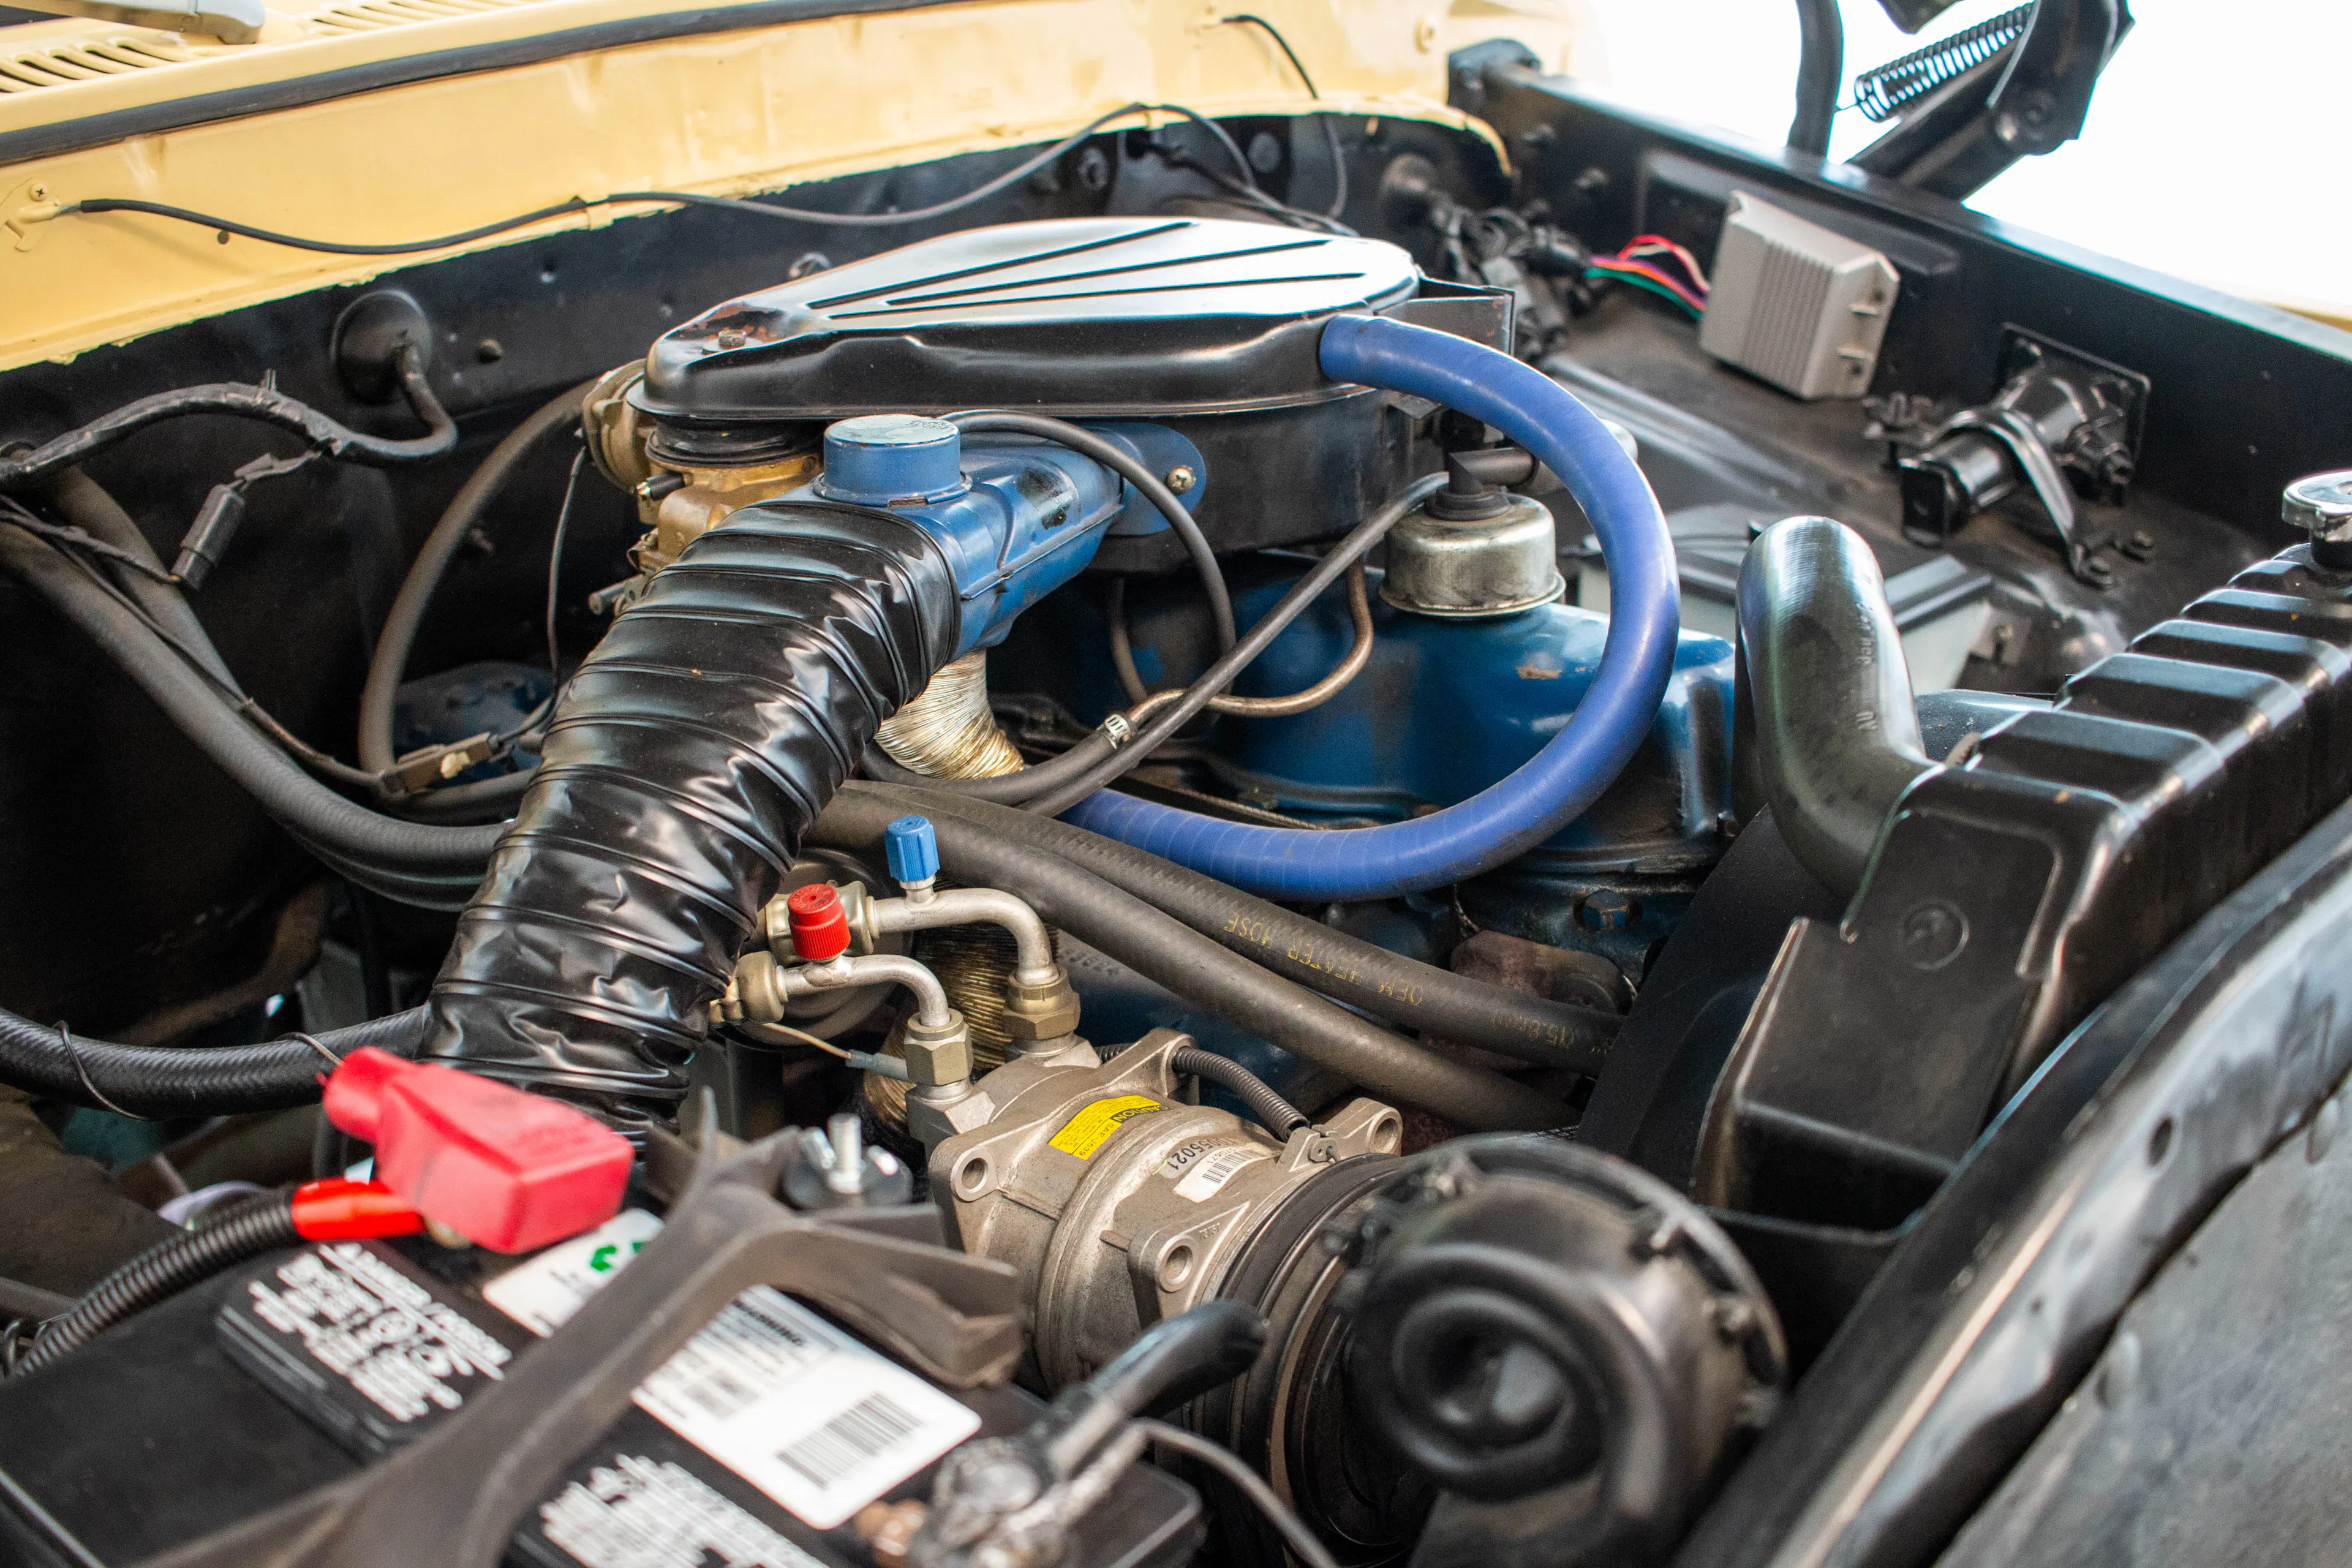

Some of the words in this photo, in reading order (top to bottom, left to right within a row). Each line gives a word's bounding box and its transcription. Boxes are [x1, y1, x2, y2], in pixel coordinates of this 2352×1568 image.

[1225, 912, 1273, 949] HOSE
[1286, 939, 1363, 986] HEATER
[1378, 979, 1424, 1006] OEM
[1112, 1104, 1169, 1123] CAUTION
[1079, 1123, 1115, 1156] SAE-J639
